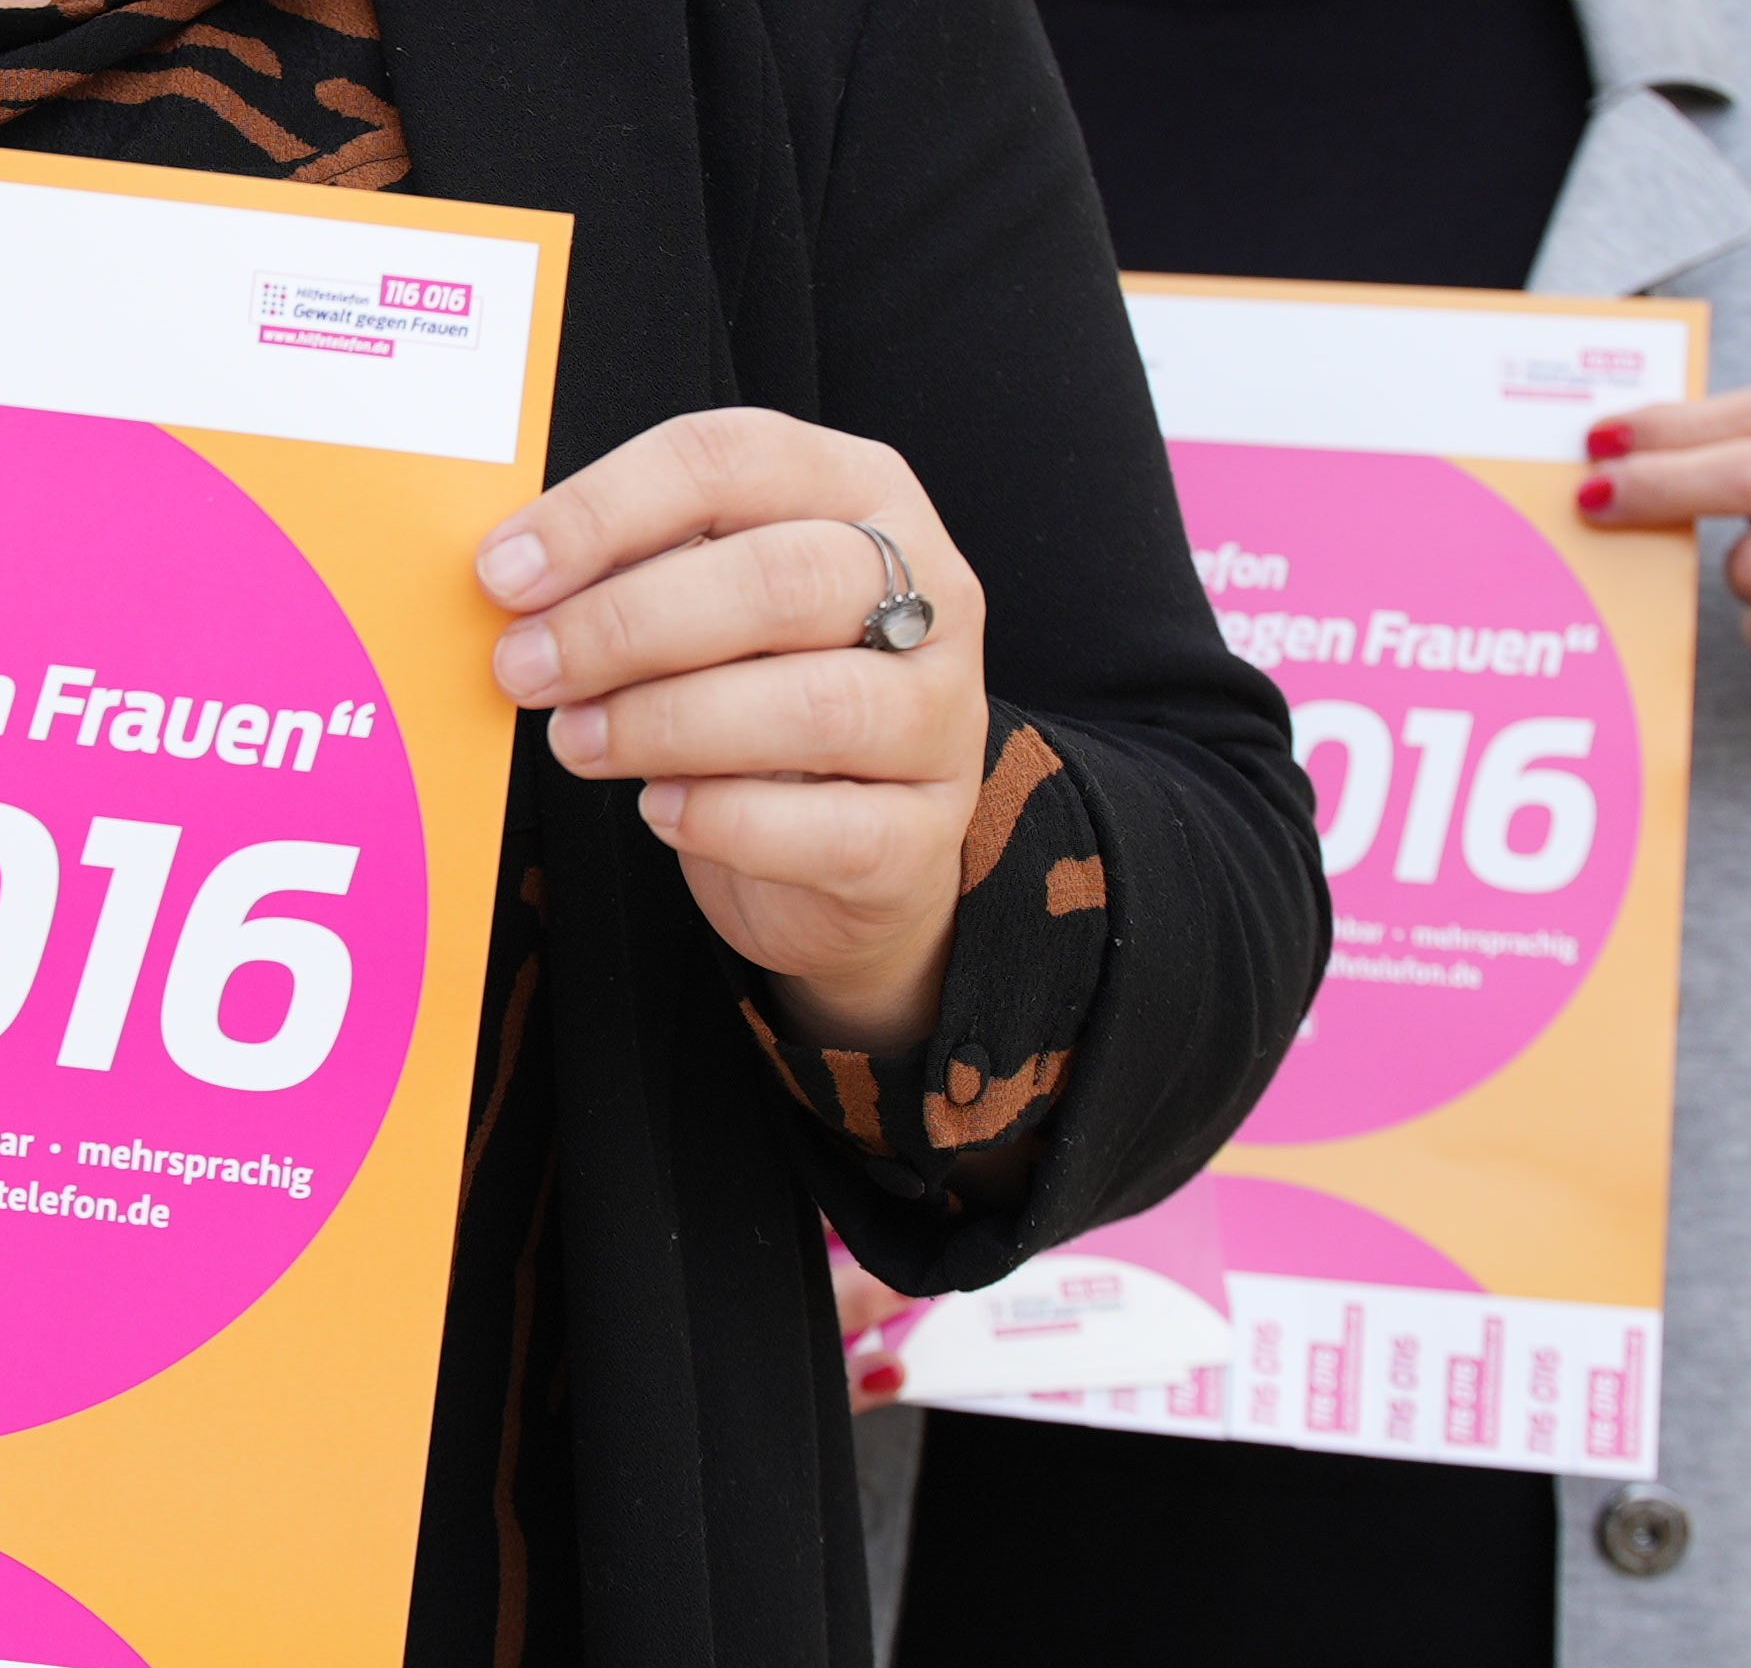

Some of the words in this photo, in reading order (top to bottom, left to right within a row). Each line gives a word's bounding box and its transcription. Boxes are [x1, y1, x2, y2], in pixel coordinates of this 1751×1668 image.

[293, 303, 353, 324] Gewalt
[354, 312, 408, 331] gegen
[410, 316, 469, 338] Frauen
[383, 279, 420, 307] 116
[422, 284, 467, 313] 016
[1213, 609, 1358, 670] egen
[28, 664, 376, 774] Frauen“
[1289, 698, 1598, 895] 016
[77, 1136, 314, 1200] mehrsprachig
